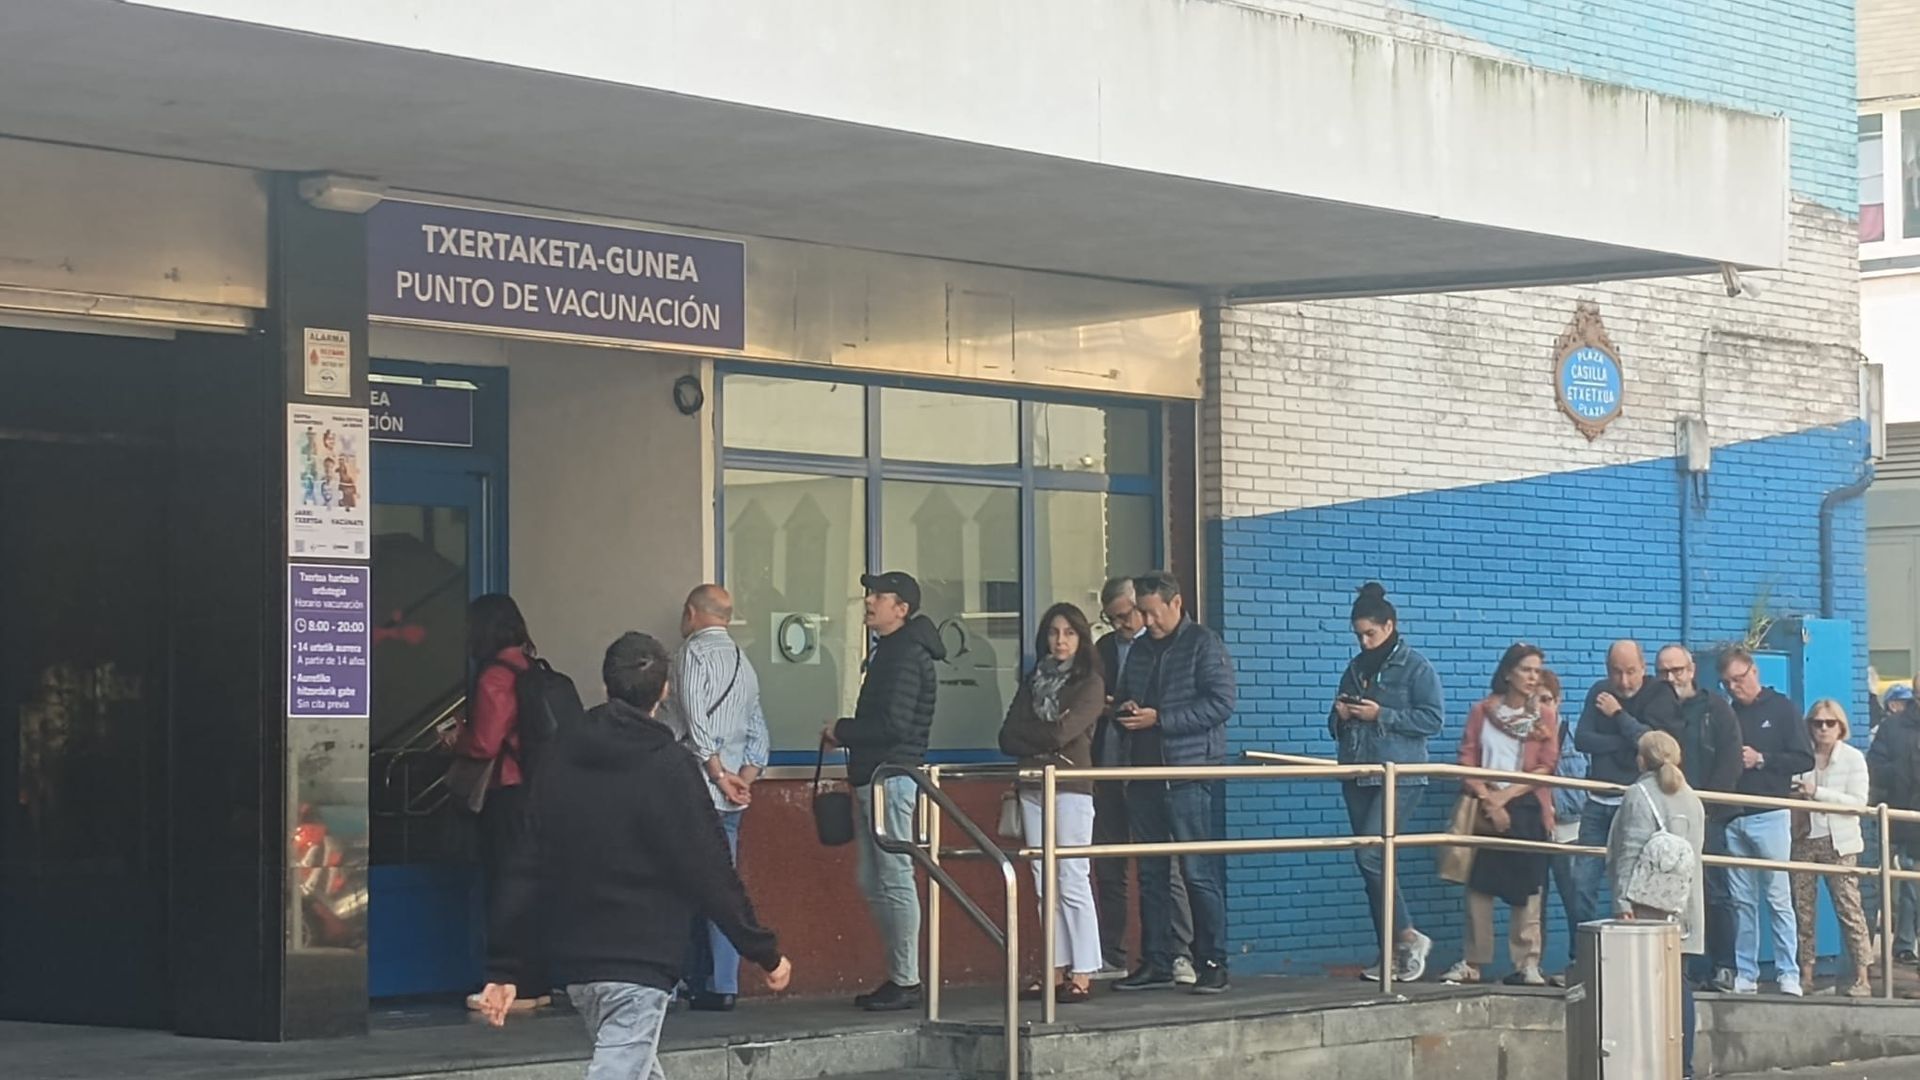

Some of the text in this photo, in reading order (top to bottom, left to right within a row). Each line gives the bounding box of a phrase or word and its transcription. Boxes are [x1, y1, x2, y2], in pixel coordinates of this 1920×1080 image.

[422, 224, 699, 282] TXERTAKETA-GUNEA
[396, 270, 720, 330] PUNTO DE VACUNACIÓN
[1577, 351, 1604, 364] PLAZA
[1571, 364, 1608, 382] CASILLA
[1567, 386, 1614, 403] ETXETXUA
[1578, 403, 1606, 417] PLAZA
[295, 597, 322, 607] Horario
[337, 621, 364, 633] 20:00
[298, 642, 308, 651] 14
[297, 655, 304, 664] A
[325, 656, 336, 665] de
[337, 656, 347, 665] 14
[297, 699, 350, 710] Sin cita previa
